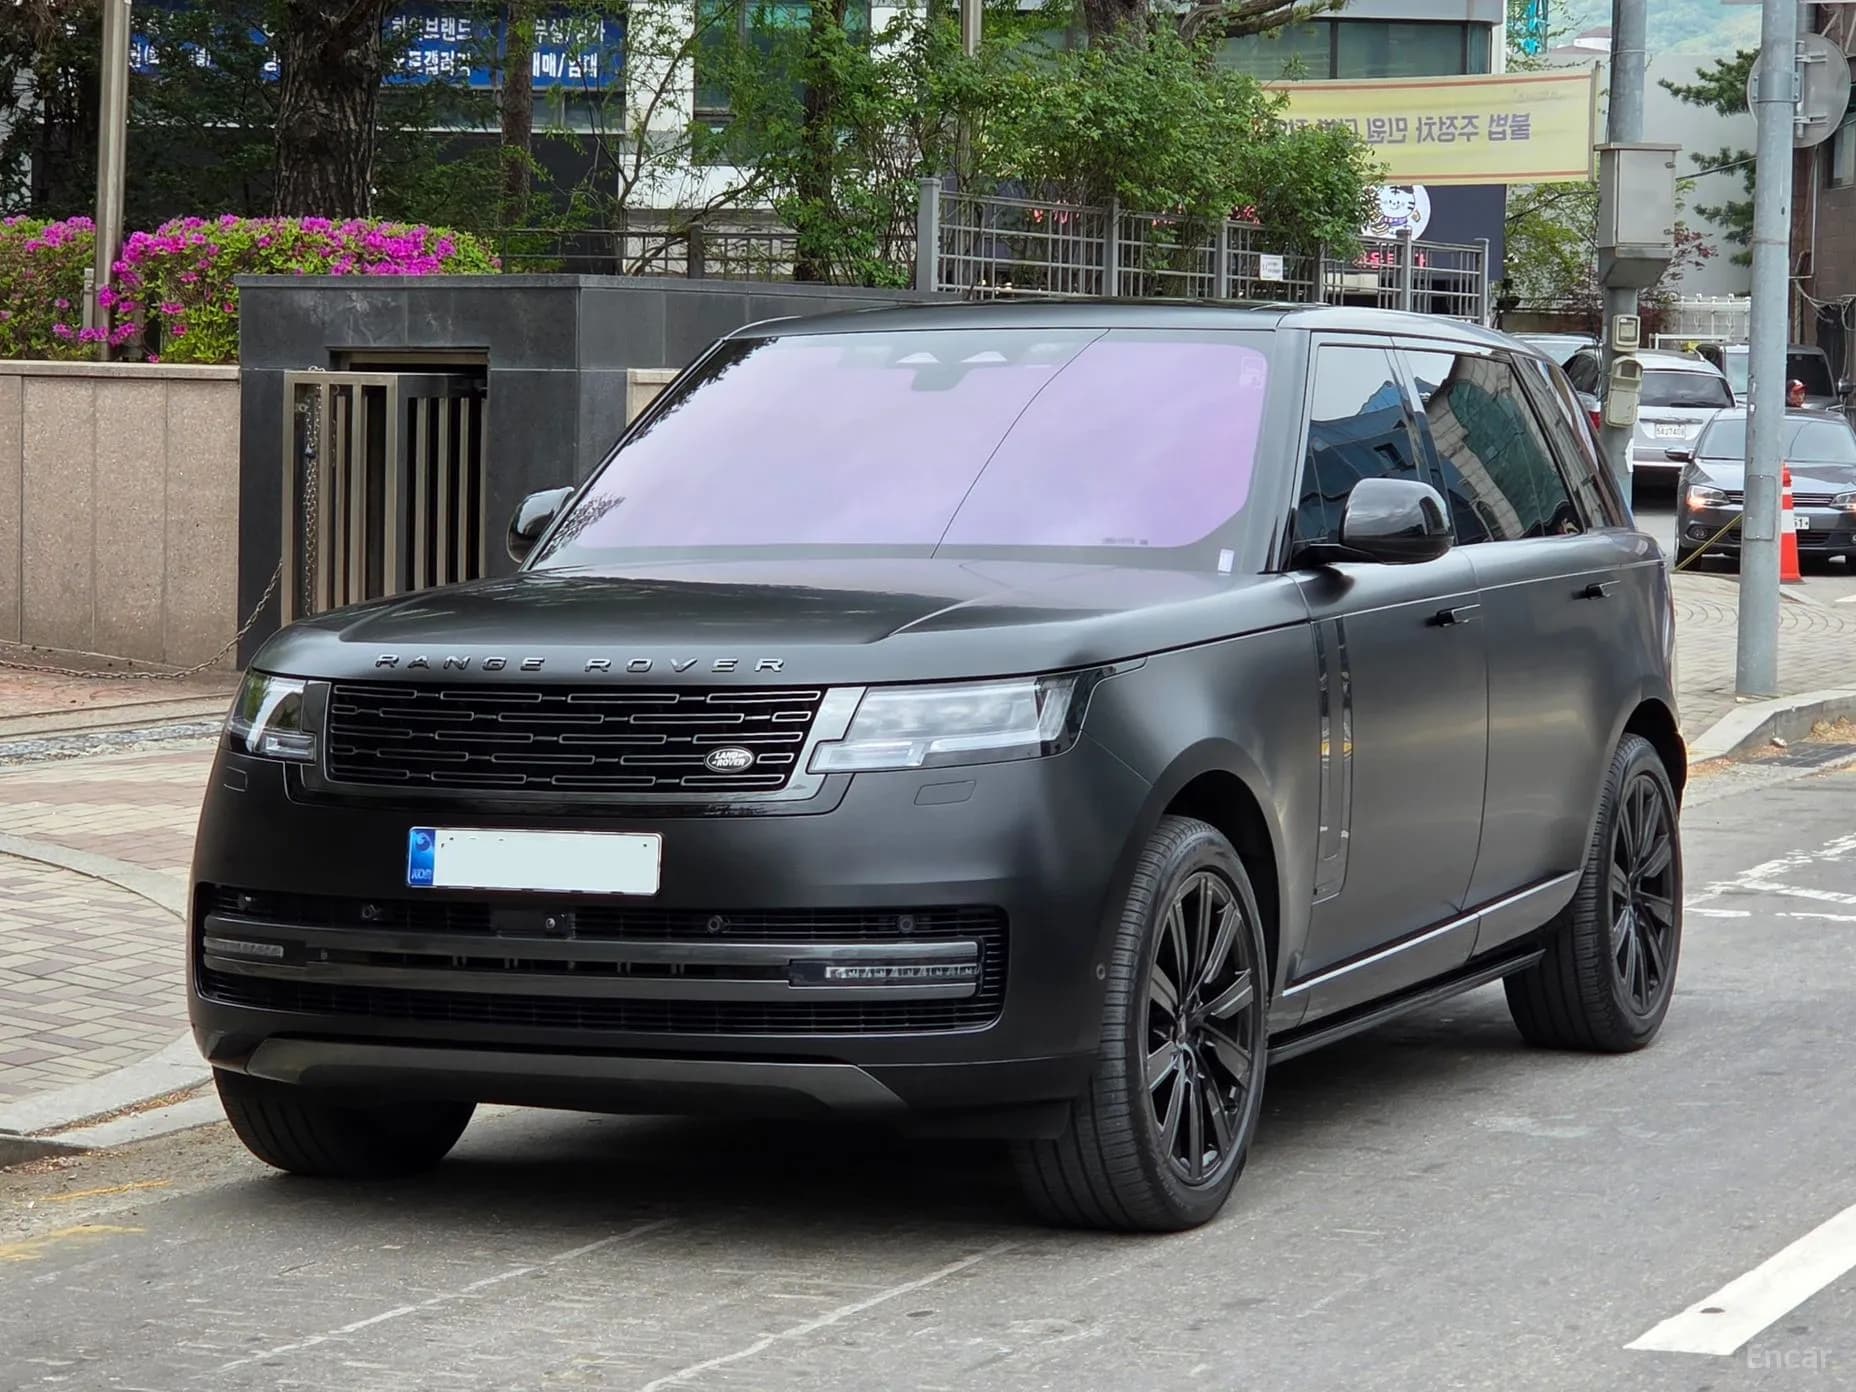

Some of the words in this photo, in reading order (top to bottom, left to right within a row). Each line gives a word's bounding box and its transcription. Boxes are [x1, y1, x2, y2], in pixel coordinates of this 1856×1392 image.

[375, 654, 546, 672] RANGE
[584, 657, 785, 673] ROVER
[715, 751, 739, 760] LAND
[716, 758, 746, 767] ROVER
